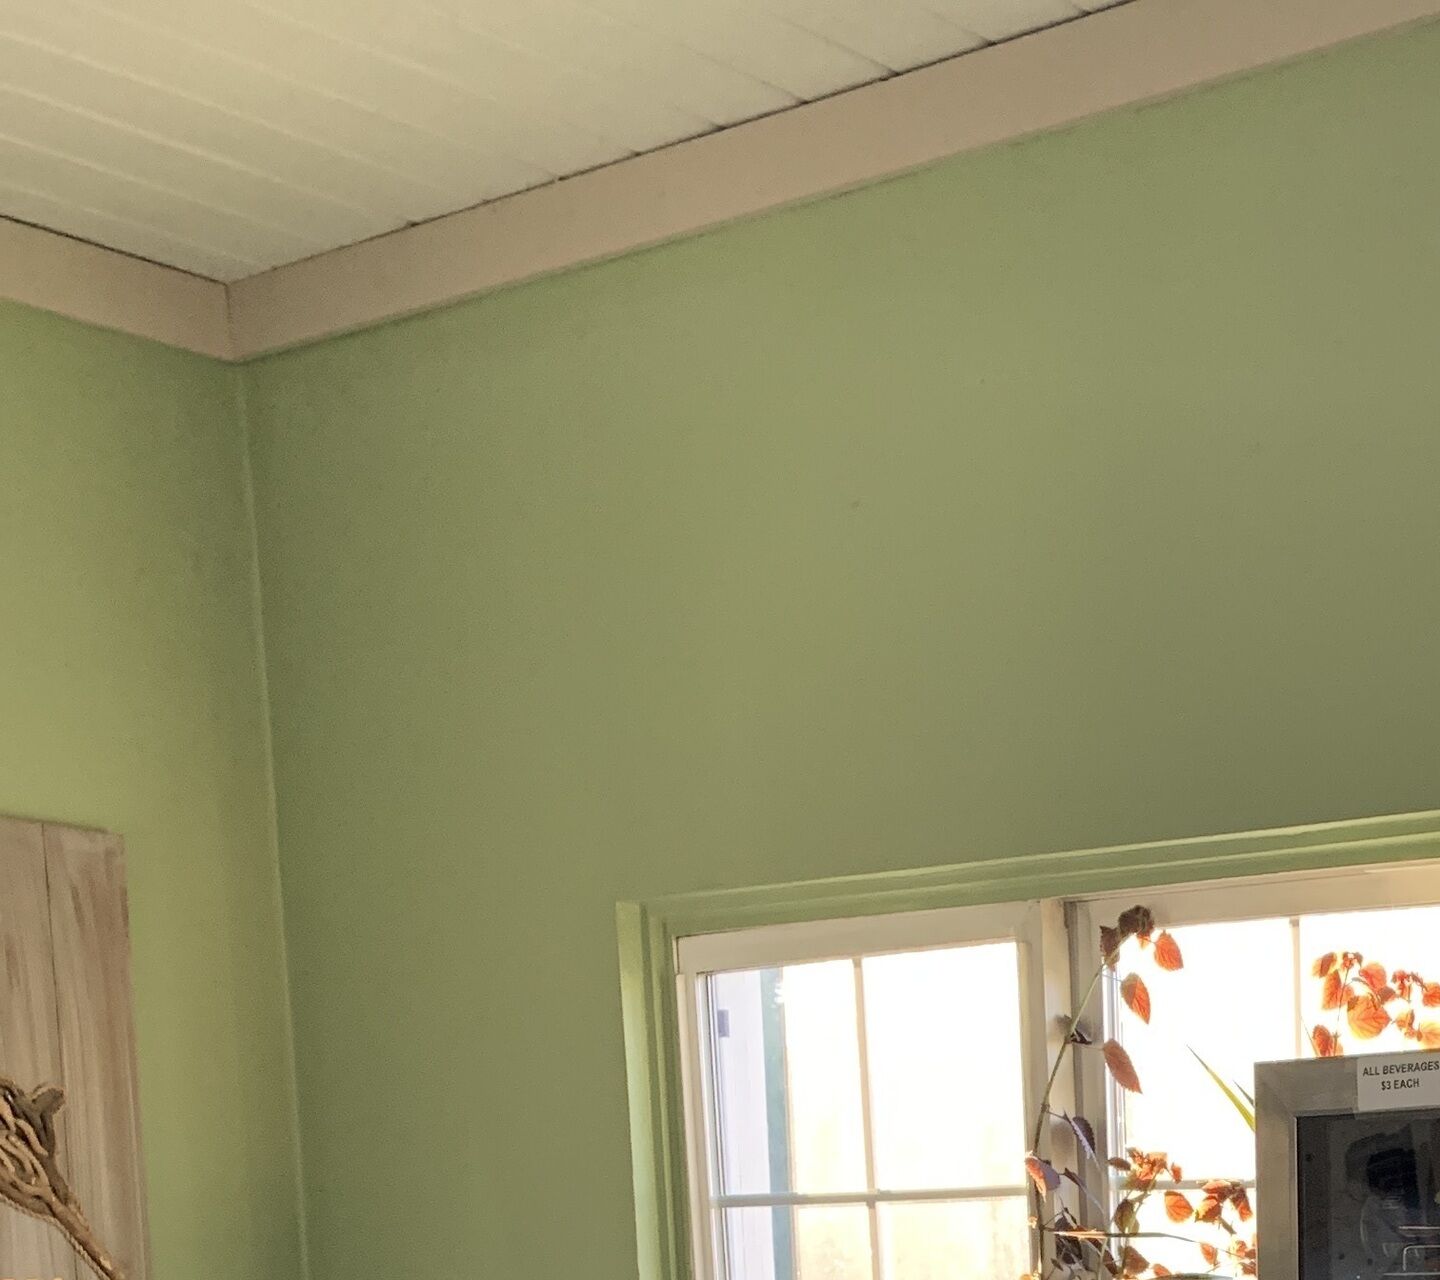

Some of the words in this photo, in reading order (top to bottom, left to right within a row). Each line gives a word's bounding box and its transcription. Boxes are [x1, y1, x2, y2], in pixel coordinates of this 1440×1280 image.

[1362, 1066, 1380, 1077] ALL
[1382, 1060, 1440, 1075] BEVERAGES
[1381, 1080, 1392, 1091] $3
[1393, 1078, 1420, 1090] EACH
